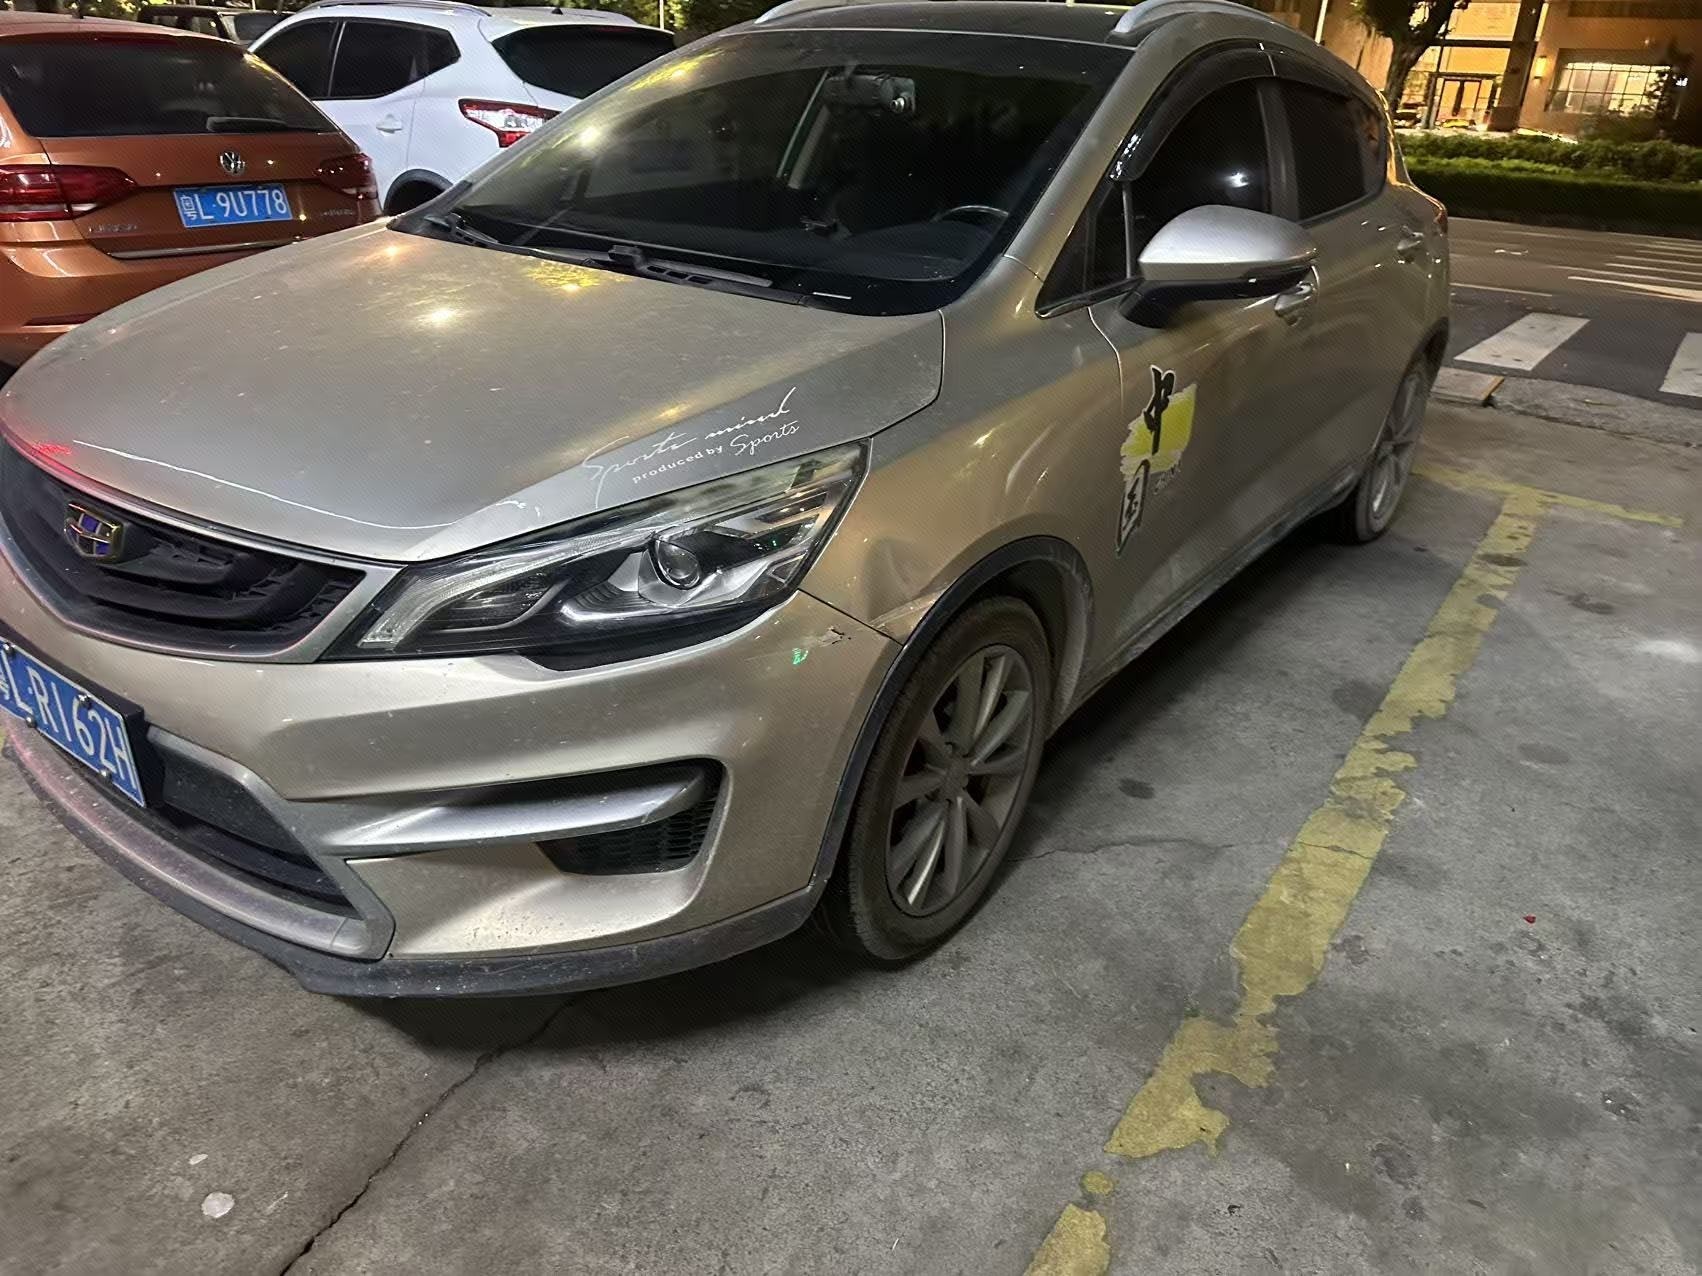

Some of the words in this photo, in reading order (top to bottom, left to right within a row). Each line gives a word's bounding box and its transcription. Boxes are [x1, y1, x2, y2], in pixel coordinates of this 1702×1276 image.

[631, 451, 703, 484] produced
[705, 445, 724, 460] by
[729, 420, 800, 456] Sports
